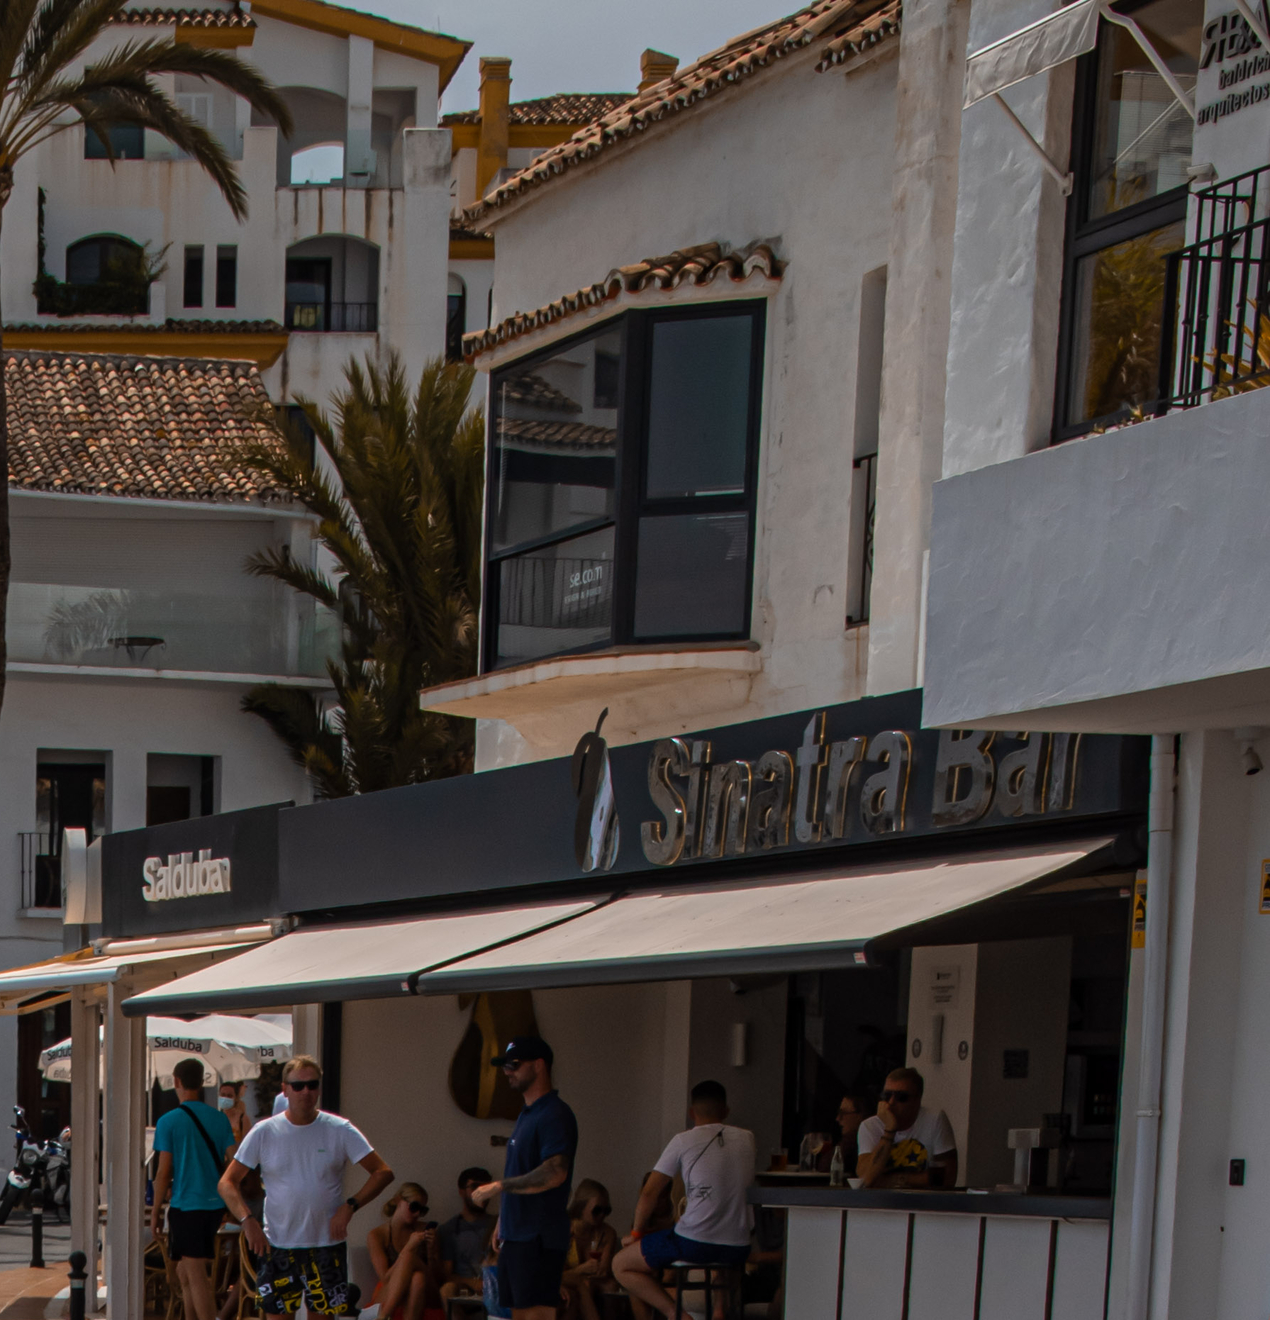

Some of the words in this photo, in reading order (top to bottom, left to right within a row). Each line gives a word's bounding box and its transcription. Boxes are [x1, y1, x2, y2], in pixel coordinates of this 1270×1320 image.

[640, 710, 914, 867] Sinatra
[141, 848, 232, 902] Salduba
[154, 1036, 203, 1052] Salduba
